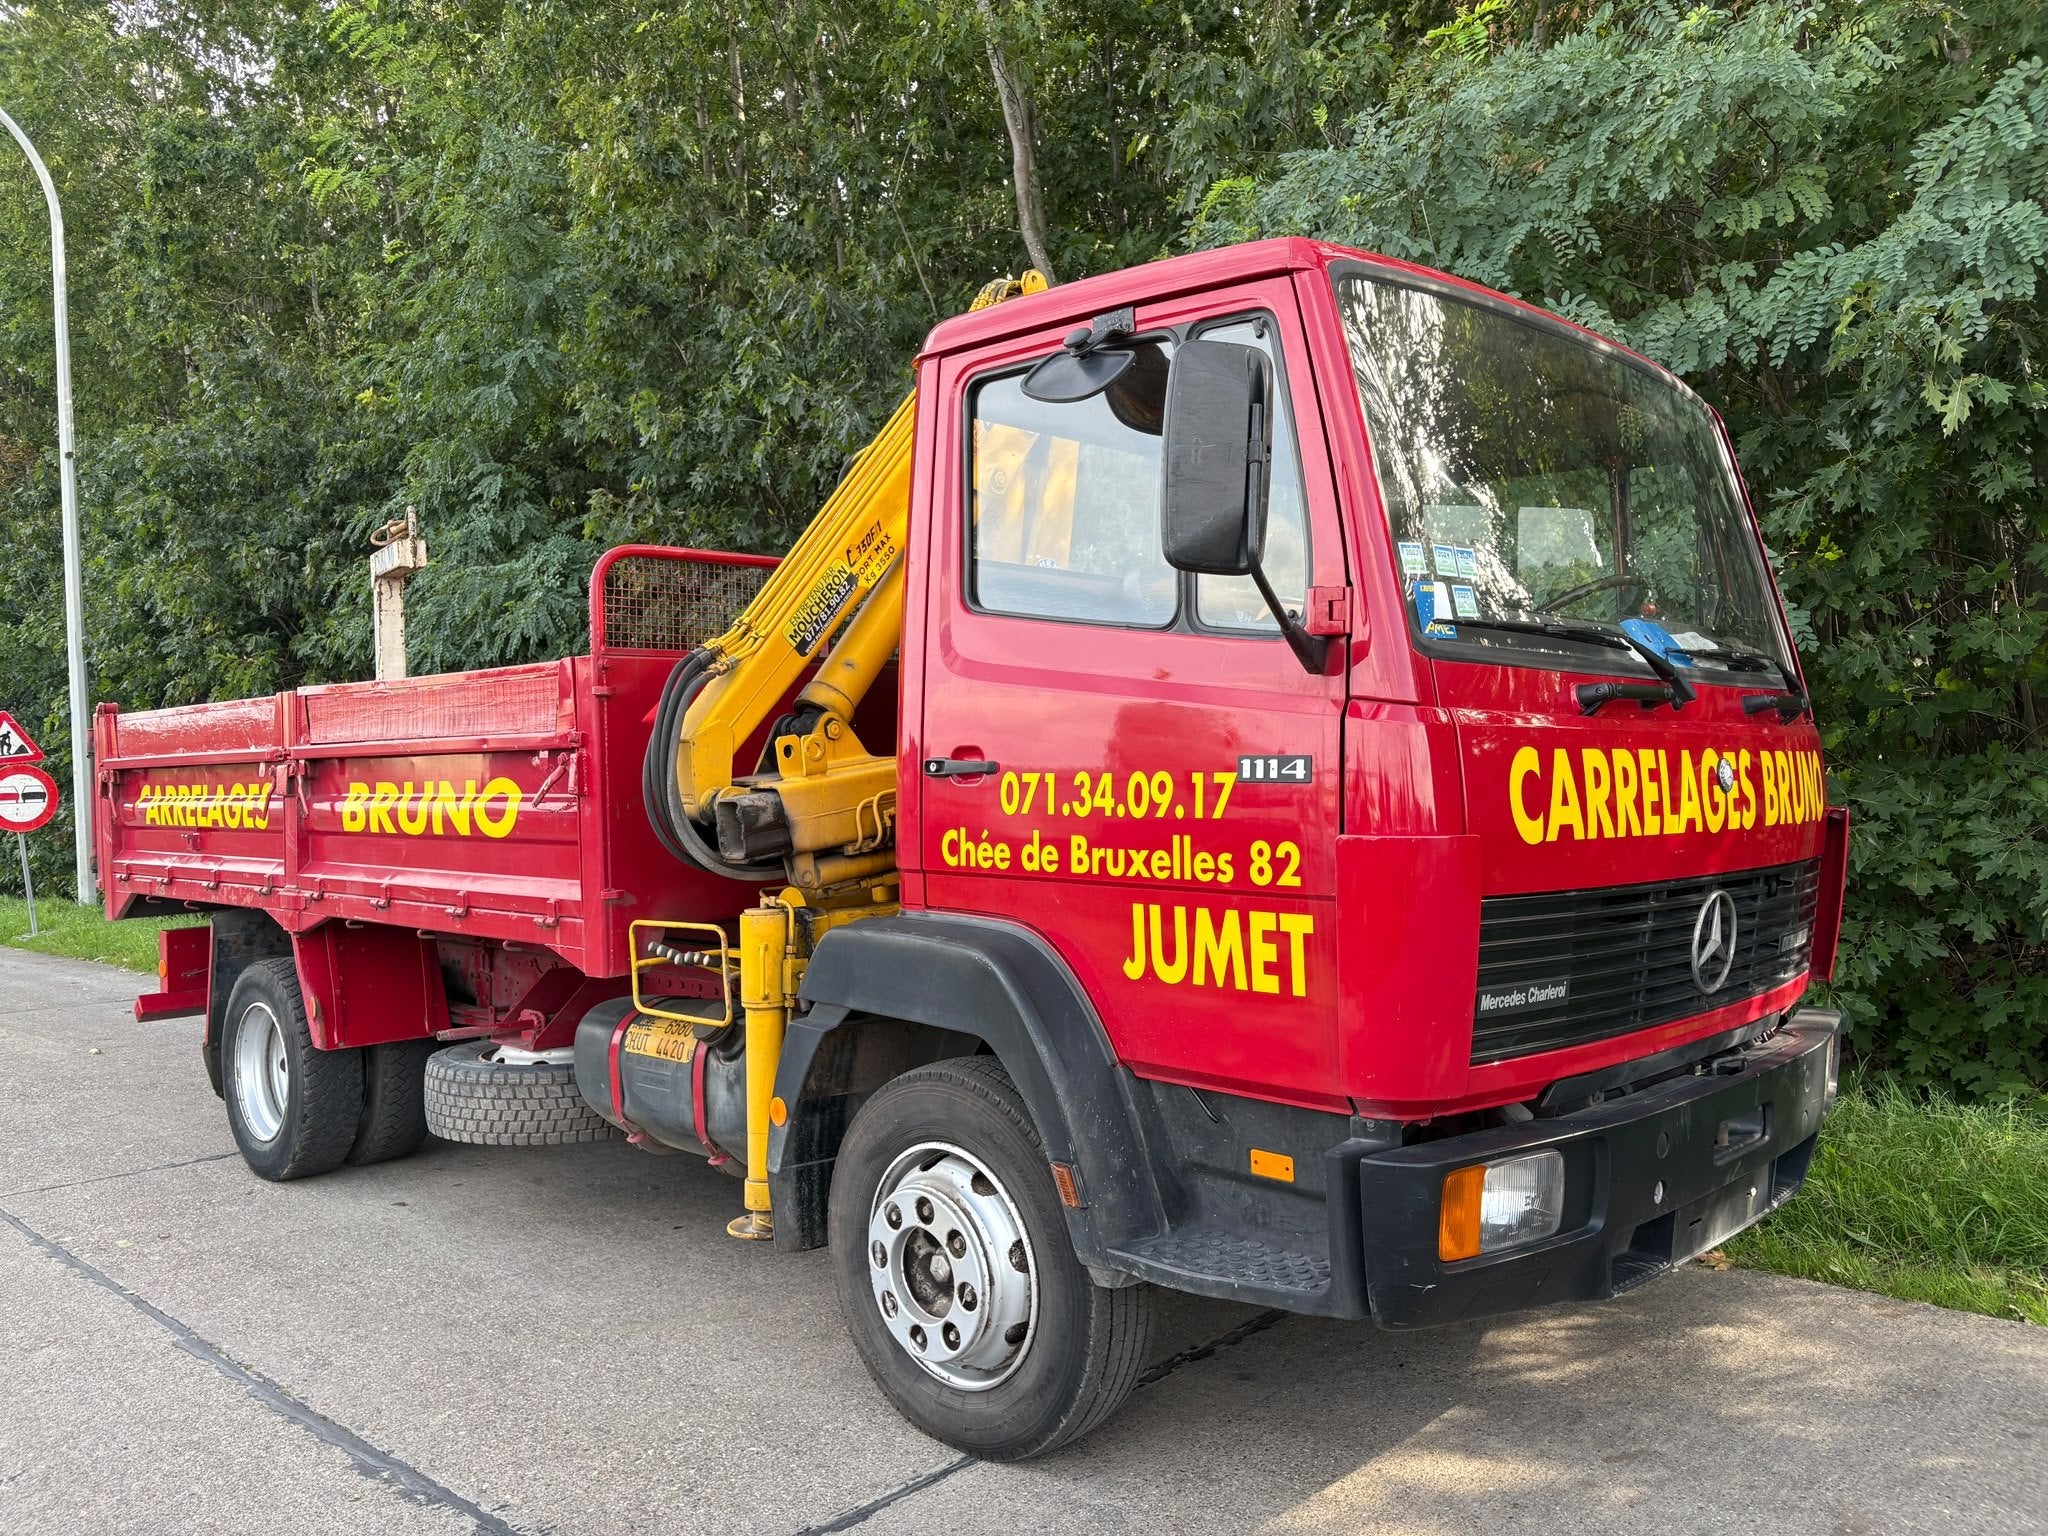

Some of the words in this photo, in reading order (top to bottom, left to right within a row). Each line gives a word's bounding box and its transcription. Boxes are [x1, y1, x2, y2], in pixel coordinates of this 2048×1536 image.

[874, 533, 892, 555] MAX
[875, 545, 895, 571] 3550
[789, 565, 849, 644] MOUCHERON
[804, 581, 850, 642] 071/81.90.82
[1000, 771, 1238, 819] 071.34.09.17
[1240, 758, 1307, 780] 1114
[1509, 746, 1756, 845] CARRELAGES
[1760, 749, 1824, 827] BRUNO
[342, 776, 523, 838] BRUNO
[941, 827, 1010, 871] Chée
[1020, 830, 1059, 873] de
[1071, 834, 1235, 883] Bruxelles
[1249, 840, 1302, 887] 82
[1122, 903, 1314, 997] JUMET
[1480, 989, 1526, 1011] Mercedes
[1528, 981, 1567, 1003] Charleroi
[656, 1038, 685, 1060] 4420
